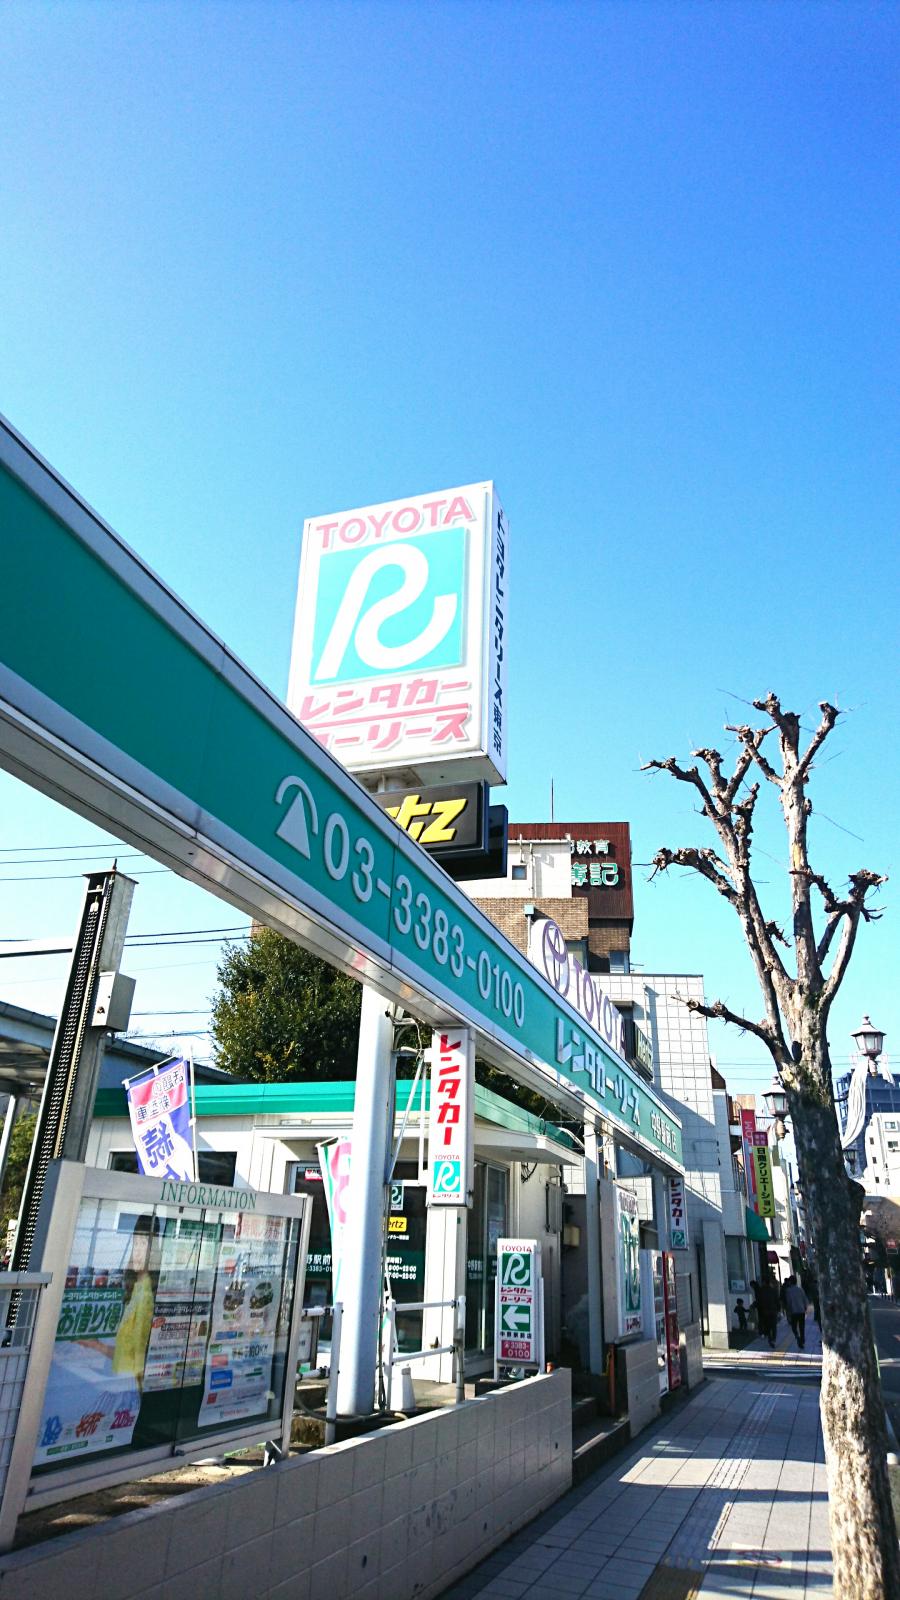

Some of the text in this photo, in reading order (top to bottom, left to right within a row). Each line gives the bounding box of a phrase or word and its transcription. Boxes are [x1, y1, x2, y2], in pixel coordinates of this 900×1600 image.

[316, 496, 473, 549] TOYOTA
[299, 678, 469, 720] レンタカー
[385, 794, 468, 844] tz
[324, 812, 525, 1028] 03-3383-0100
[573, 955, 627, 1059] TOYOTA
[437, 1034, 462, 1146] レンタカー
[160, 1181, 257, 1210] INFORMATION
[501, 1245, 532, 1253] TOYOTA
[500, 1287, 532, 1295] レンタカー
[500, 1296, 532, 1304] カーリース
